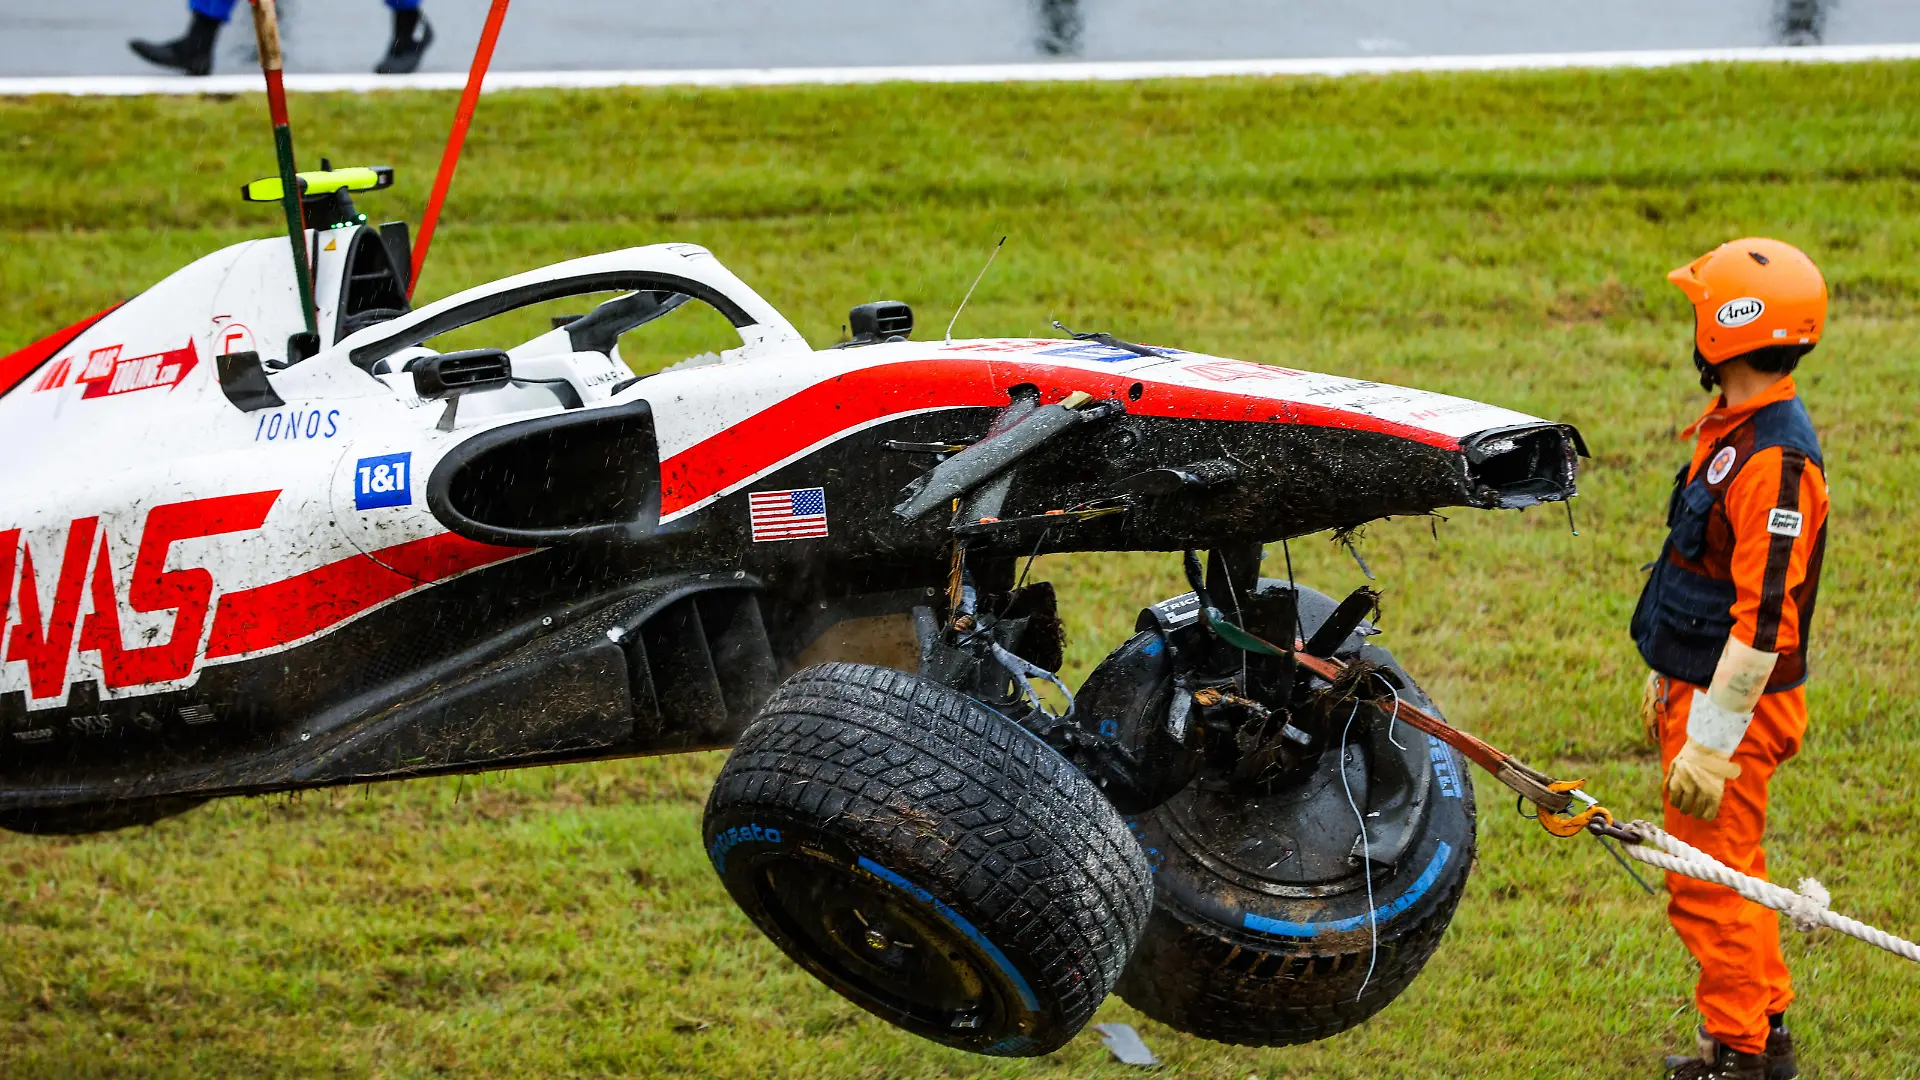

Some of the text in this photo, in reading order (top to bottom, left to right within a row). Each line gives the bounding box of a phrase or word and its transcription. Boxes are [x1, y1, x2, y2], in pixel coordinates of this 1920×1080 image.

[1722, 300, 1756, 323] Arai
[255, 409, 341, 441] IONOS
[358, 462, 406, 494] 1&1
